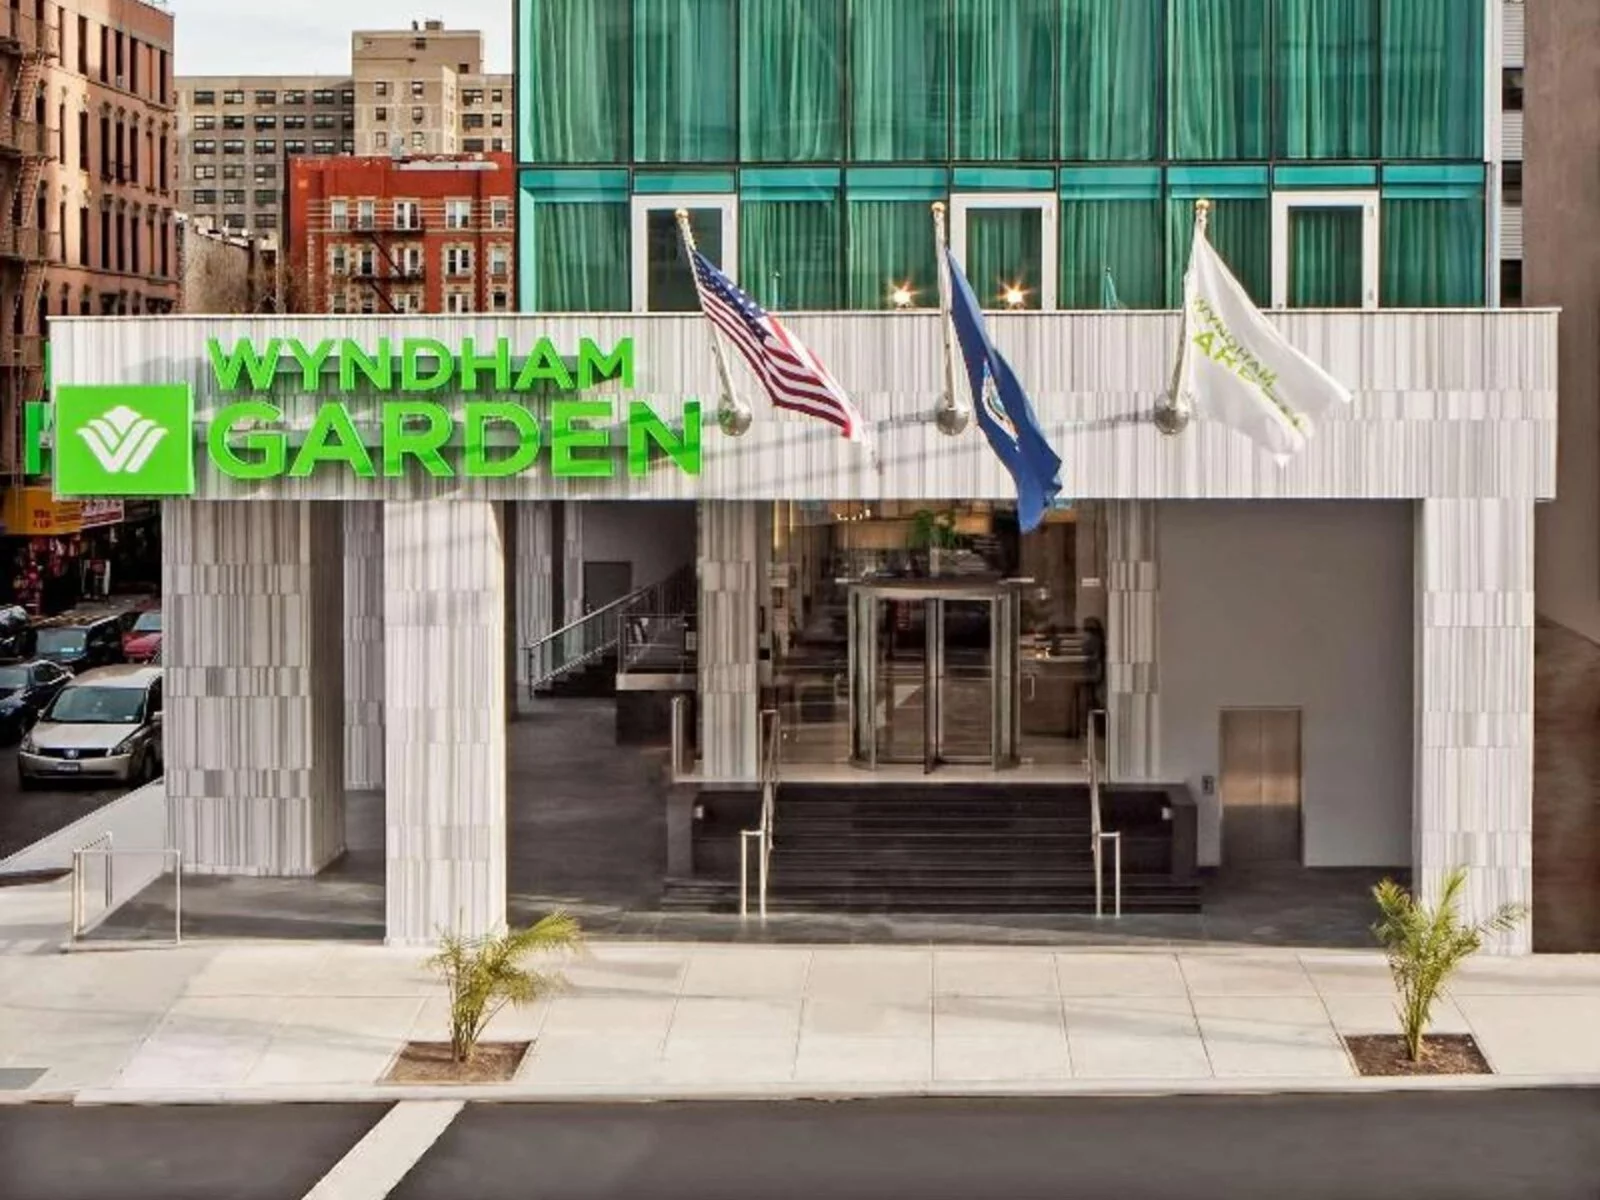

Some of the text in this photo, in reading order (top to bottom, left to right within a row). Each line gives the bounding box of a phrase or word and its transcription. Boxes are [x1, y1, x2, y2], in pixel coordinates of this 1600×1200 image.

[207, 337, 634, 392] WYNDHAM
[1193, 297, 1278, 387] WYNDHAM
[207, 401, 703, 479] GARDEN
